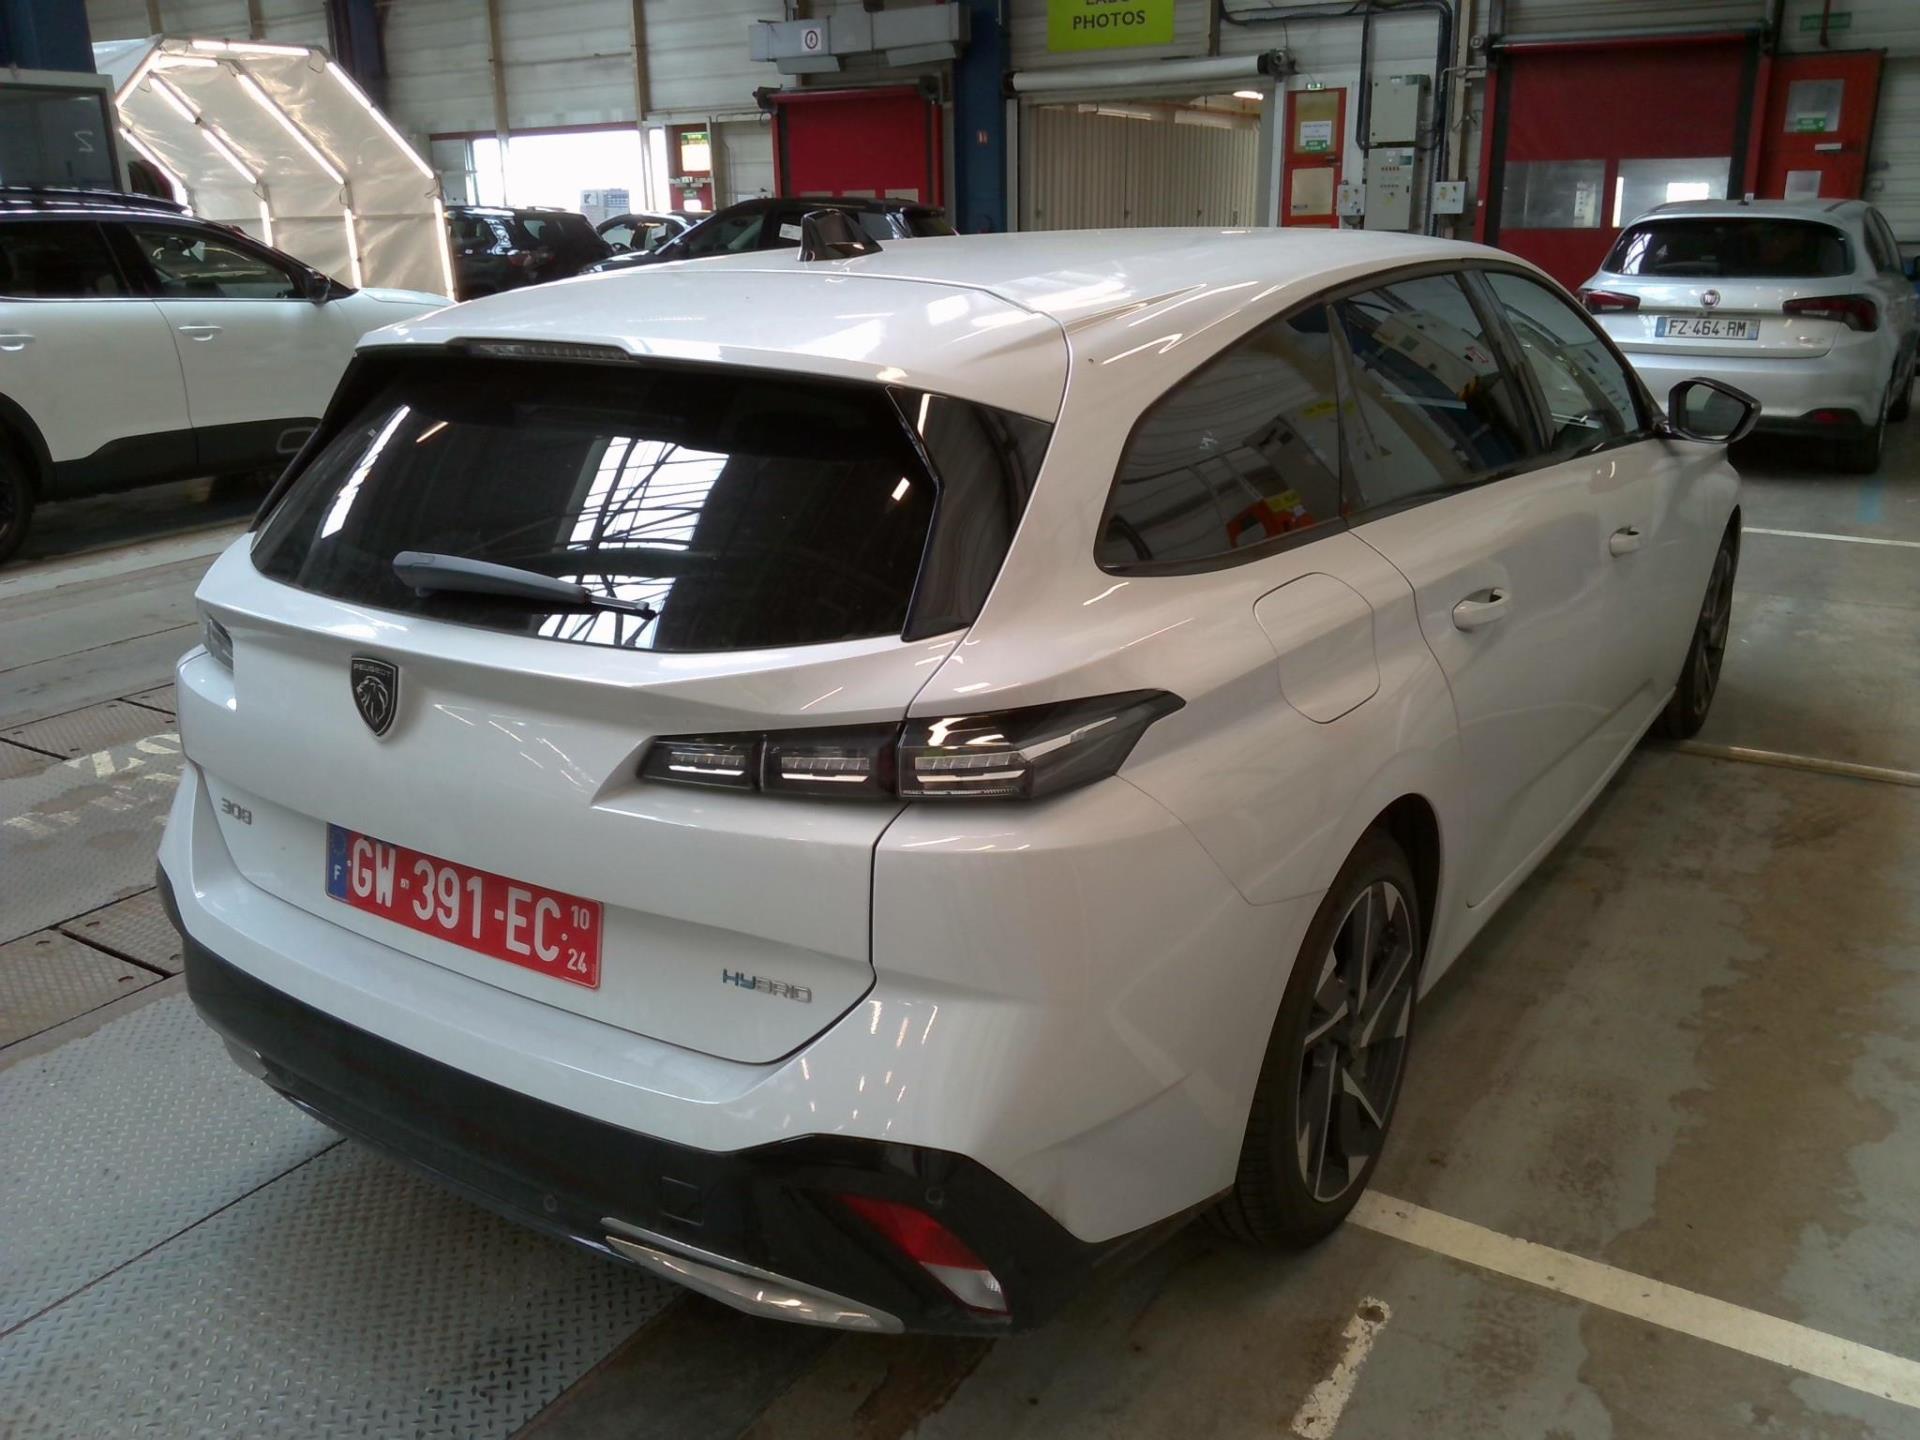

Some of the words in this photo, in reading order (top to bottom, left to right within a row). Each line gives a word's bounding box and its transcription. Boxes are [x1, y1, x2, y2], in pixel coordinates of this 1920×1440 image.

[1073, 10, 1146, 30] PHOTOS
[221, 797, 252, 825] 308
[571, 904, 590, 930] 10
[567, 948, 588, 974] 24
[722, 968, 812, 1003] HYBRID
